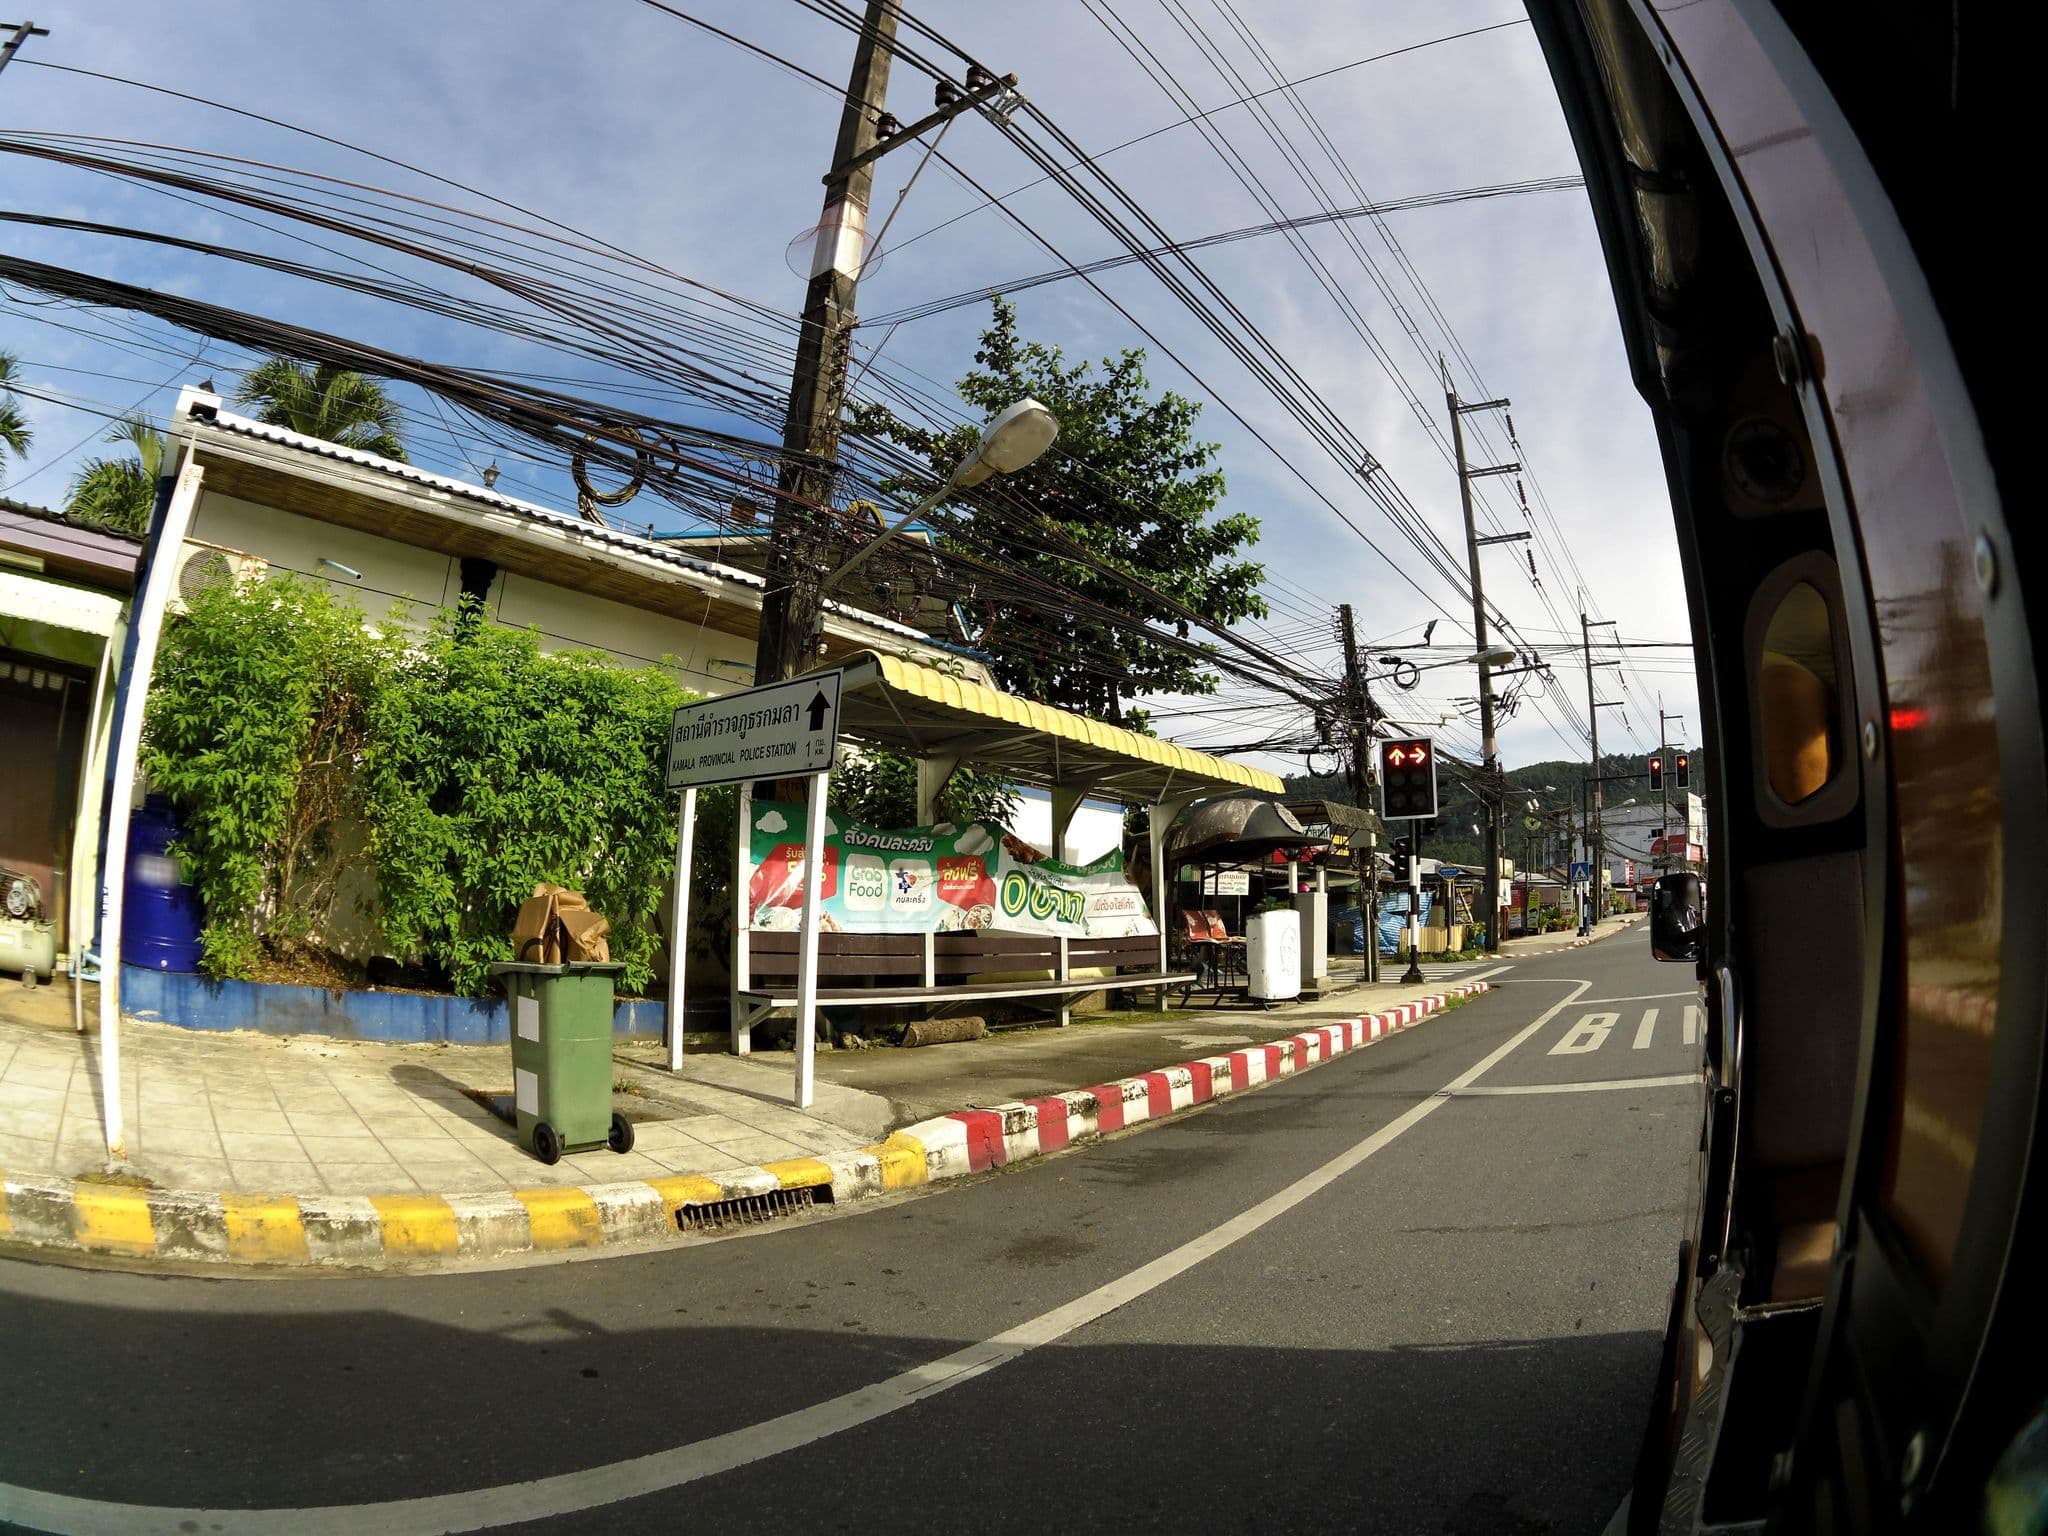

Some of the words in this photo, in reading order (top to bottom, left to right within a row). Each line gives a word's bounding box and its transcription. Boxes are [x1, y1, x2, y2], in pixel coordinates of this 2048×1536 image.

[675, 703, 800, 743] สถานีตำรวจภูธรกมลา
[672, 758, 696, 772] KAMALA
[698, 751, 736, 769] PROVINCIAL
[739, 745, 765, 762] POLICE
[765, 741, 797, 758] STATION
[805, 741, 811, 758] 1
[850, 865, 883, 882] Grab
[849, 882, 883, 898] Food
[1001, 870, 1029, 917] 0
[1028, 881, 1086, 924] บาท
